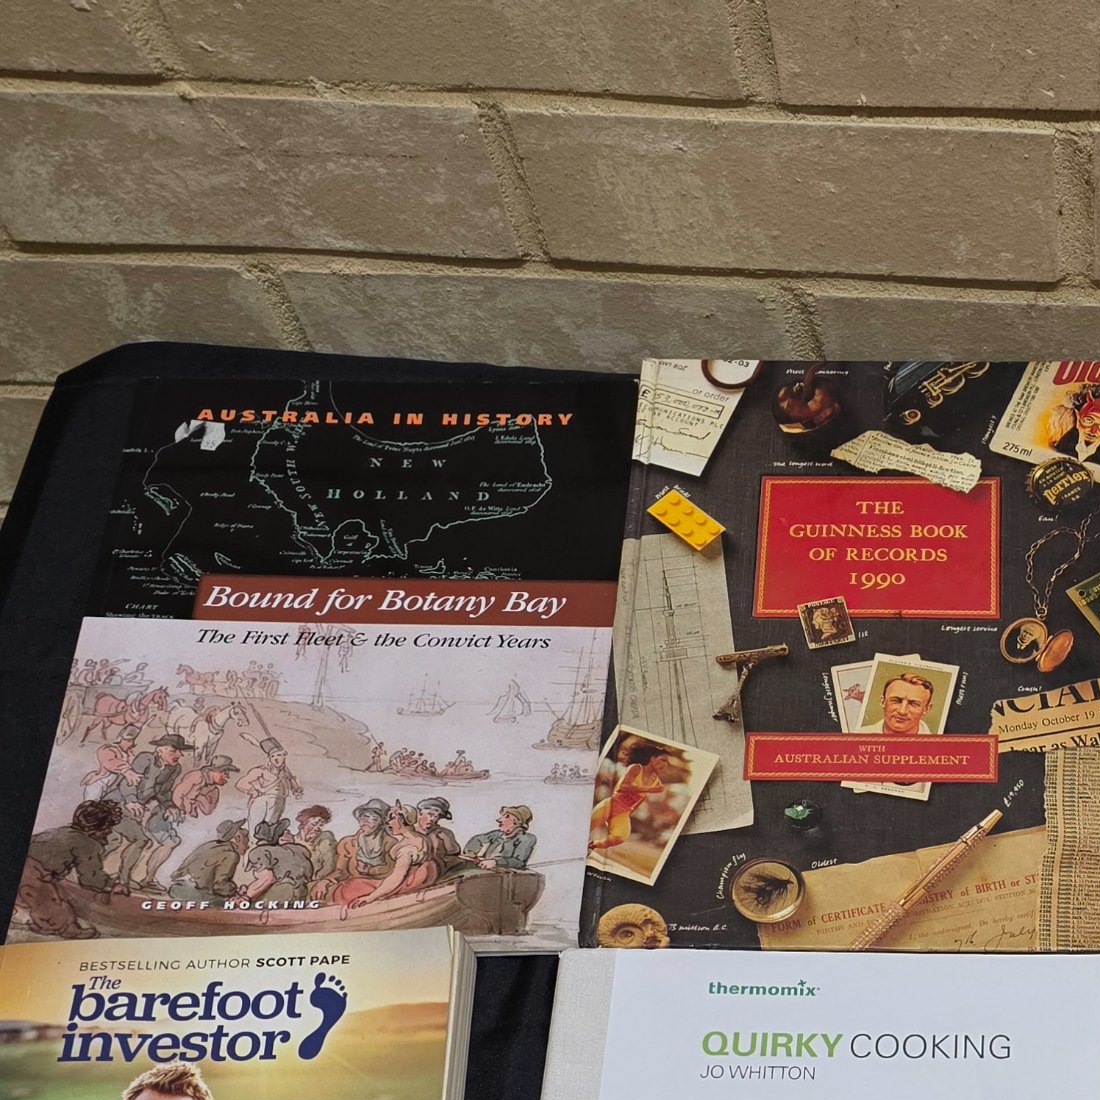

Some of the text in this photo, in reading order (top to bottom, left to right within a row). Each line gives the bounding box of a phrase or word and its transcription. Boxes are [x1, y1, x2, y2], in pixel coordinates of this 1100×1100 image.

[197, 408, 574, 427] AUSTRALIA IN HISTORY
[369, 457, 447, 469] NEW
[326, 488, 490, 501] HOLLAND
[856, 501, 904, 515] THE
[789, 524, 968, 538] GUINNESS BOOK
[809, 547, 948, 562] OF RECORDS
[850, 573, 905, 589] 1990
[203, 585, 320, 611] Bound
[315, 588, 370, 617] for
[378, 588, 495, 617] Botany
[503, 591, 567, 618] Bay
[198, 628, 552, 651] The First Fleet & the Convict Years
[999, 720, 1038, 735] Monday
[1042, 713, 1080, 727] October
[1084, 710, 1095, 720] 19
[859, 745, 886, 753] WITH
[774, 753, 970, 765] AUSTRALIAN SUPPLEMENT
[975, 880, 1006, 895] BIRTH
[141, 899, 321, 910] GEOFF HOCKING
[821, 902, 887, 923] CERTIFICATE
[79, 955, 351, 972] BESTSELLING AUTHOR SCOTT PAPE
[89, 975, 121, 990] The
[708, 979, 817, 997] thermomix
[68, 980, 304, 1022] barefoot
[57, 1022, 291, 1063] investor
[702, 1030, 1012, 1061] QUIRKY COOKING
[700, 1064, 816, 1081] JO WHITTON
